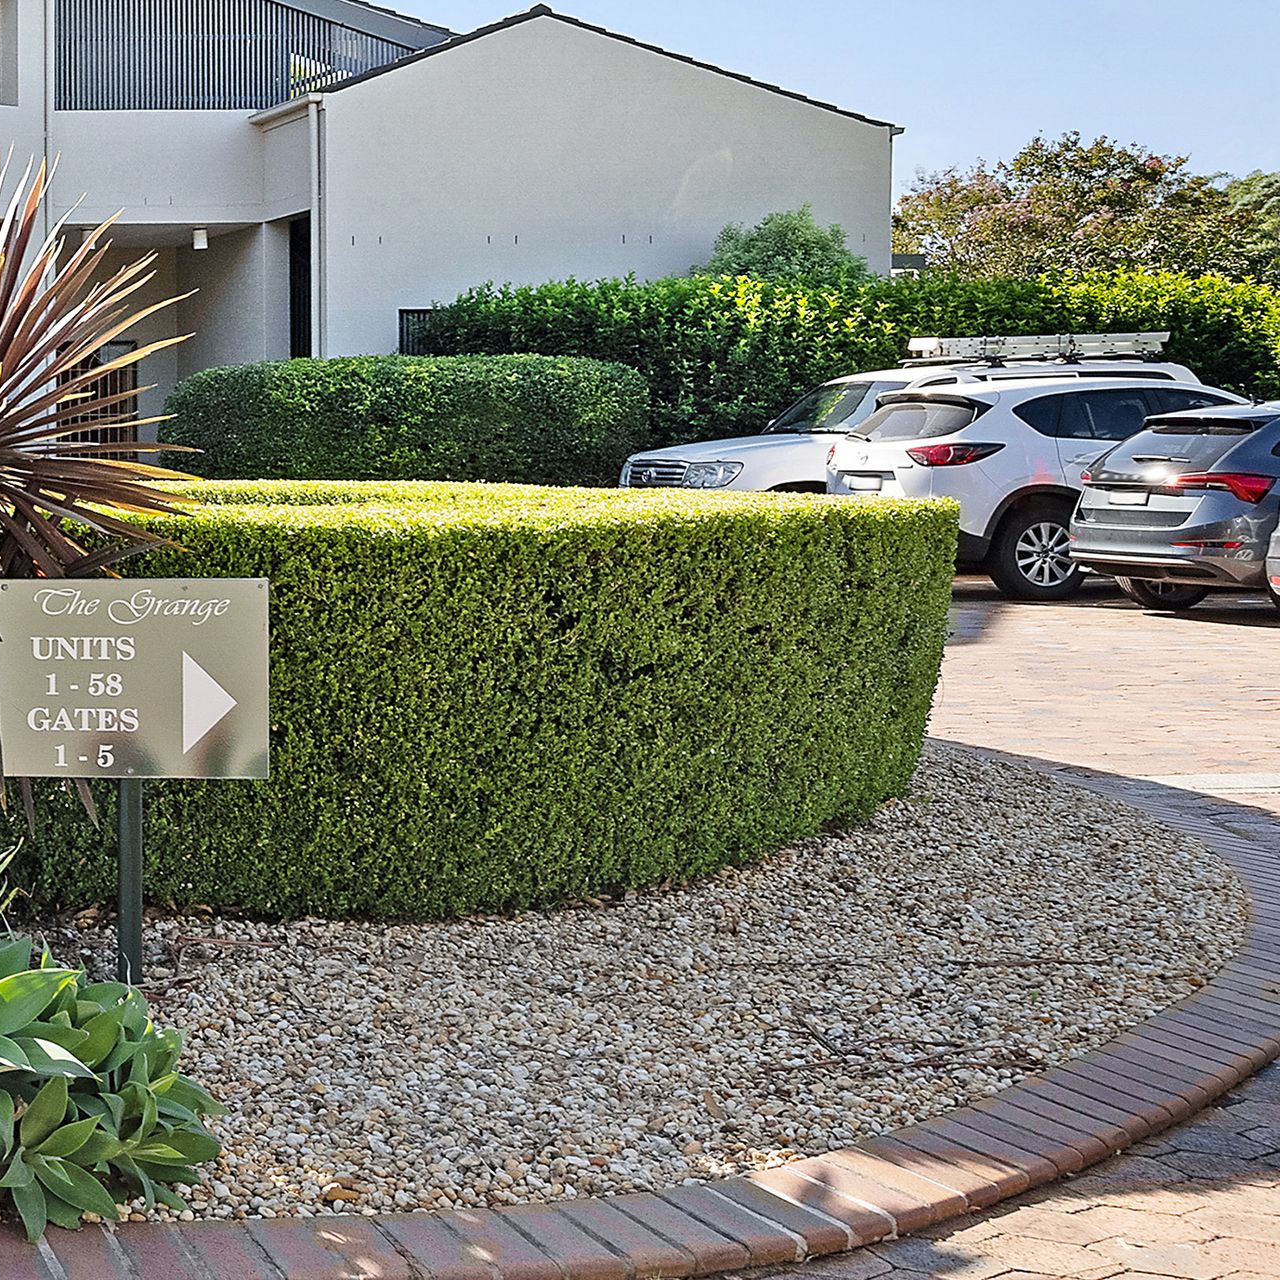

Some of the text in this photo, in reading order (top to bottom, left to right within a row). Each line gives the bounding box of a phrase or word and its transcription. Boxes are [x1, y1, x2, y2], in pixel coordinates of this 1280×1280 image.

[33, 588, 231, 626] The Grange
[30, 636, 136, 661] UNITS
[45, 673, 60, 696] 1
[88, 673, 123, 697] 58
[27, 707, 139, 732] GATES
[54, 744, 69, 767] 1
[97, 744, 115, 768] 5
